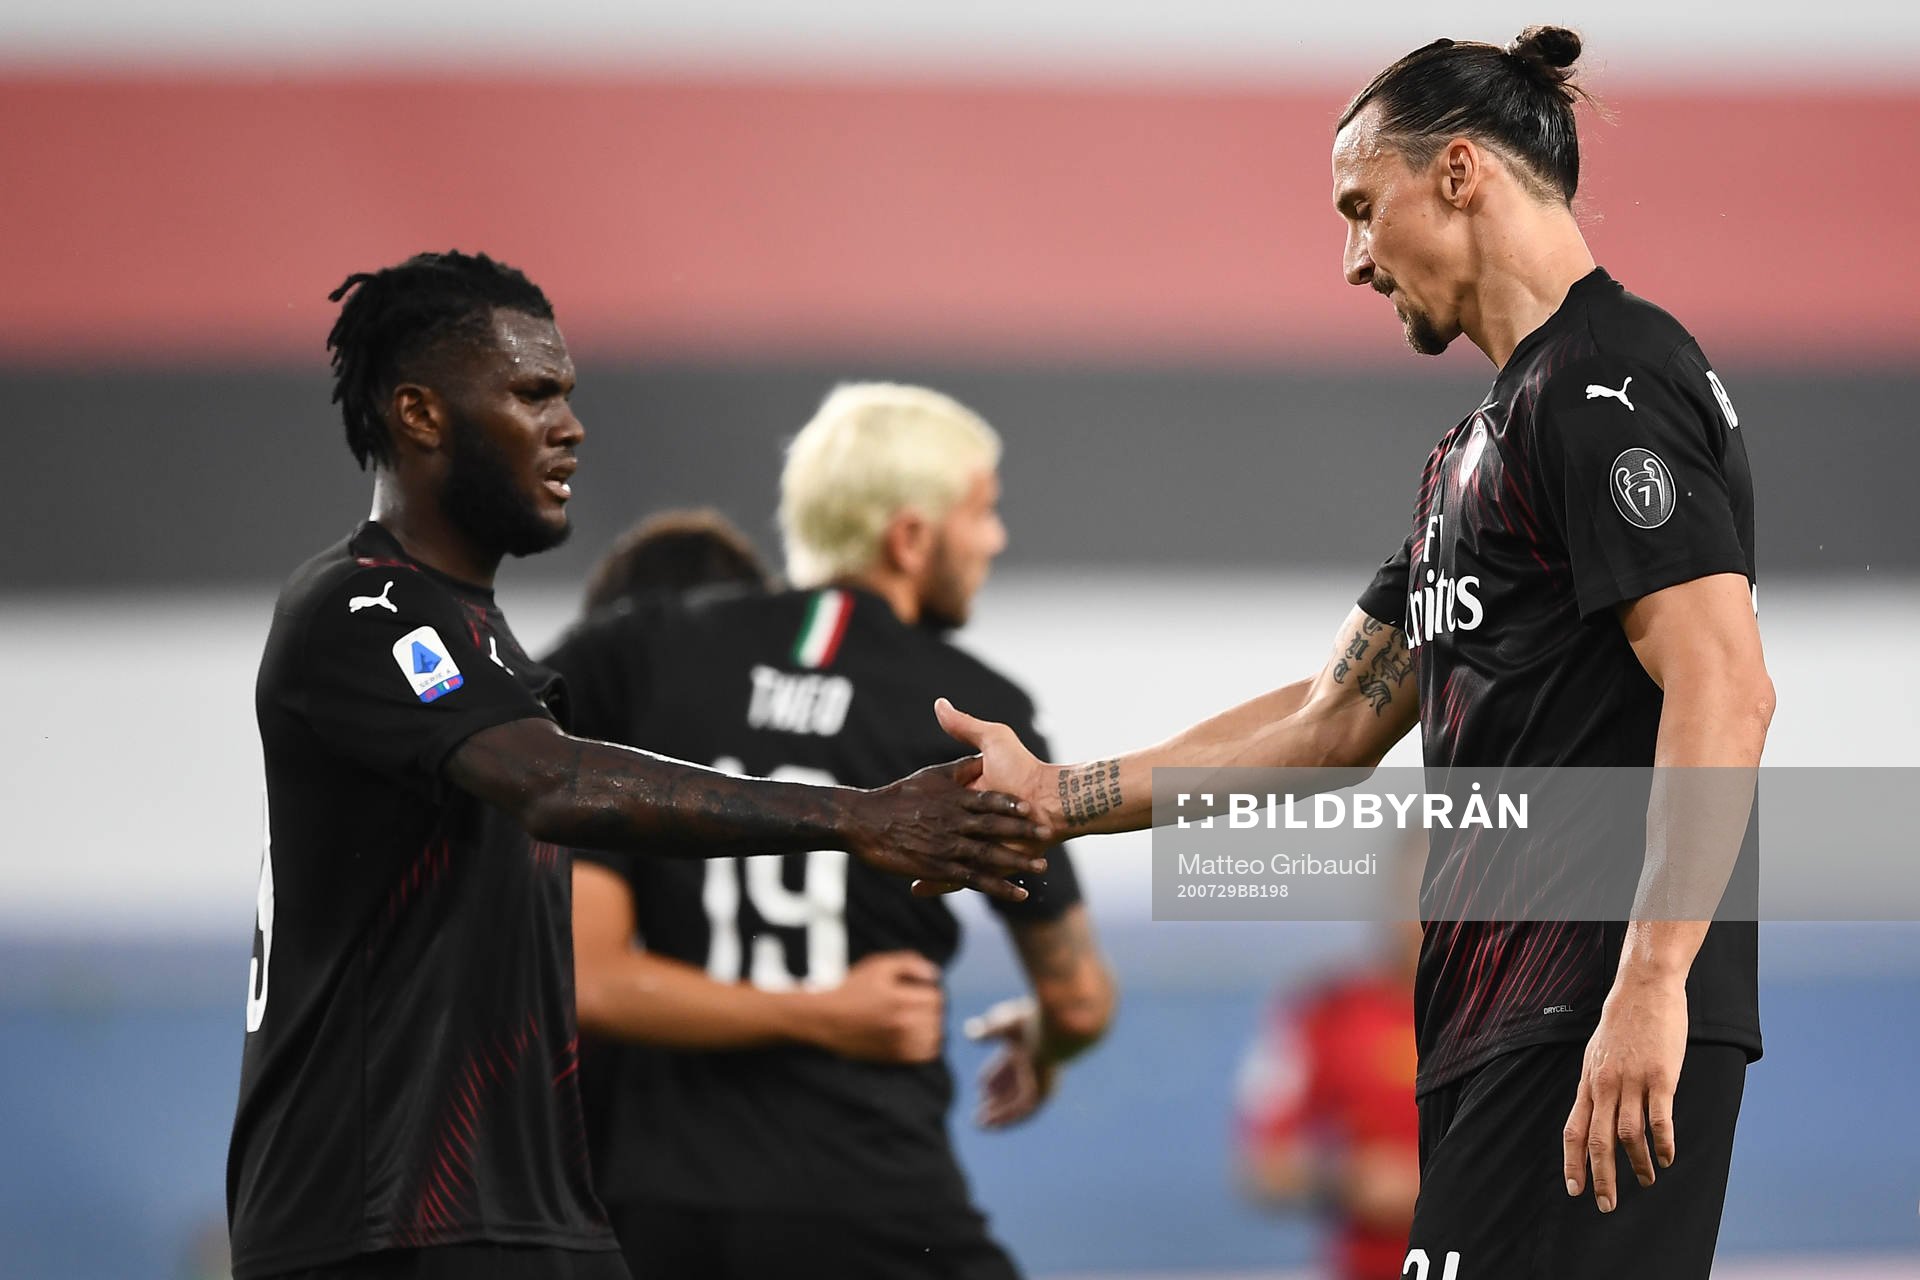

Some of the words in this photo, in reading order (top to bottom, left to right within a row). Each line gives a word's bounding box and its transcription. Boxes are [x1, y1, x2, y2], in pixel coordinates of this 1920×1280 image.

[1637, 485, 1650, 507] 7
[748, 664, 853, 736] THEO
[1543, 1004, 1574, 1015] DRYCELL
